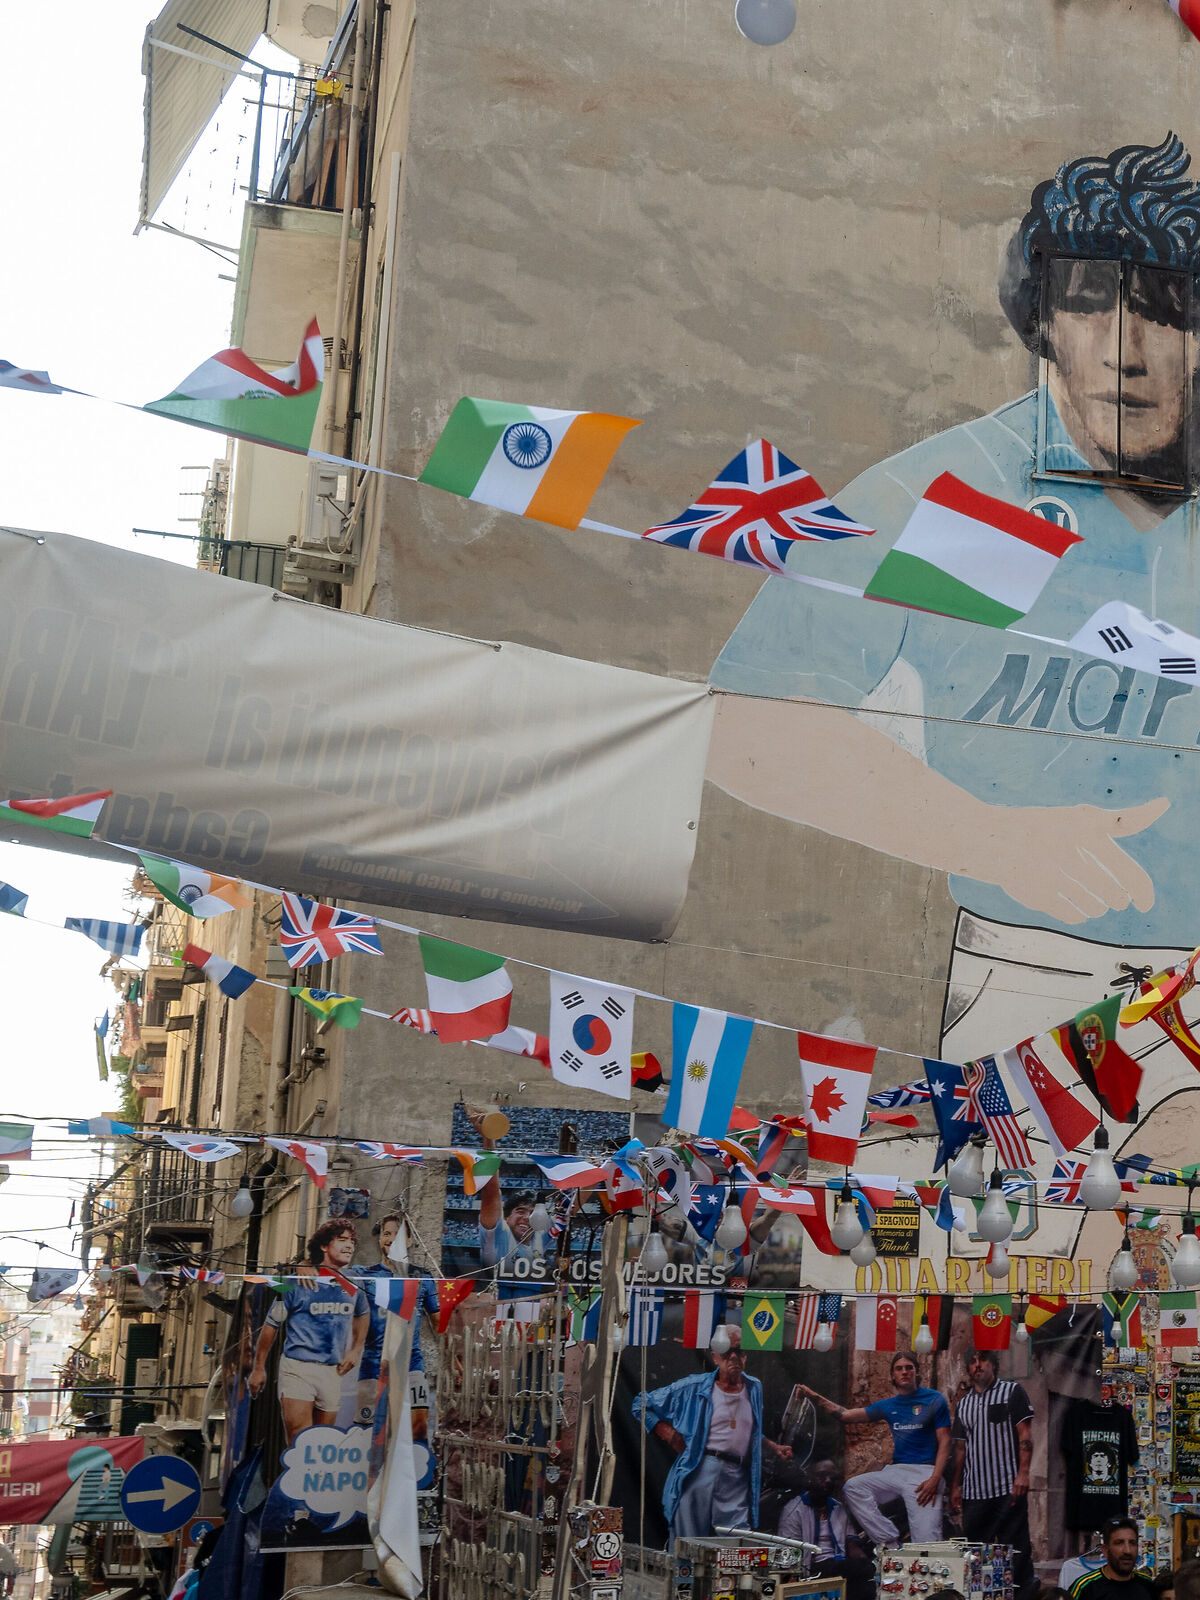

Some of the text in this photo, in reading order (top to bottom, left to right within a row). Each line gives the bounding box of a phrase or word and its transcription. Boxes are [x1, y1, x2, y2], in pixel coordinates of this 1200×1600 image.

[879, 1216, 919, 1226] SPAGNOLI
[499, 1257, 547, 1279] LOS
[310, 1302, 355, 1315] CIRIO
[410, 1385, 428, 1405] 14
[303, 1444, 362, 1465] L'Oro
